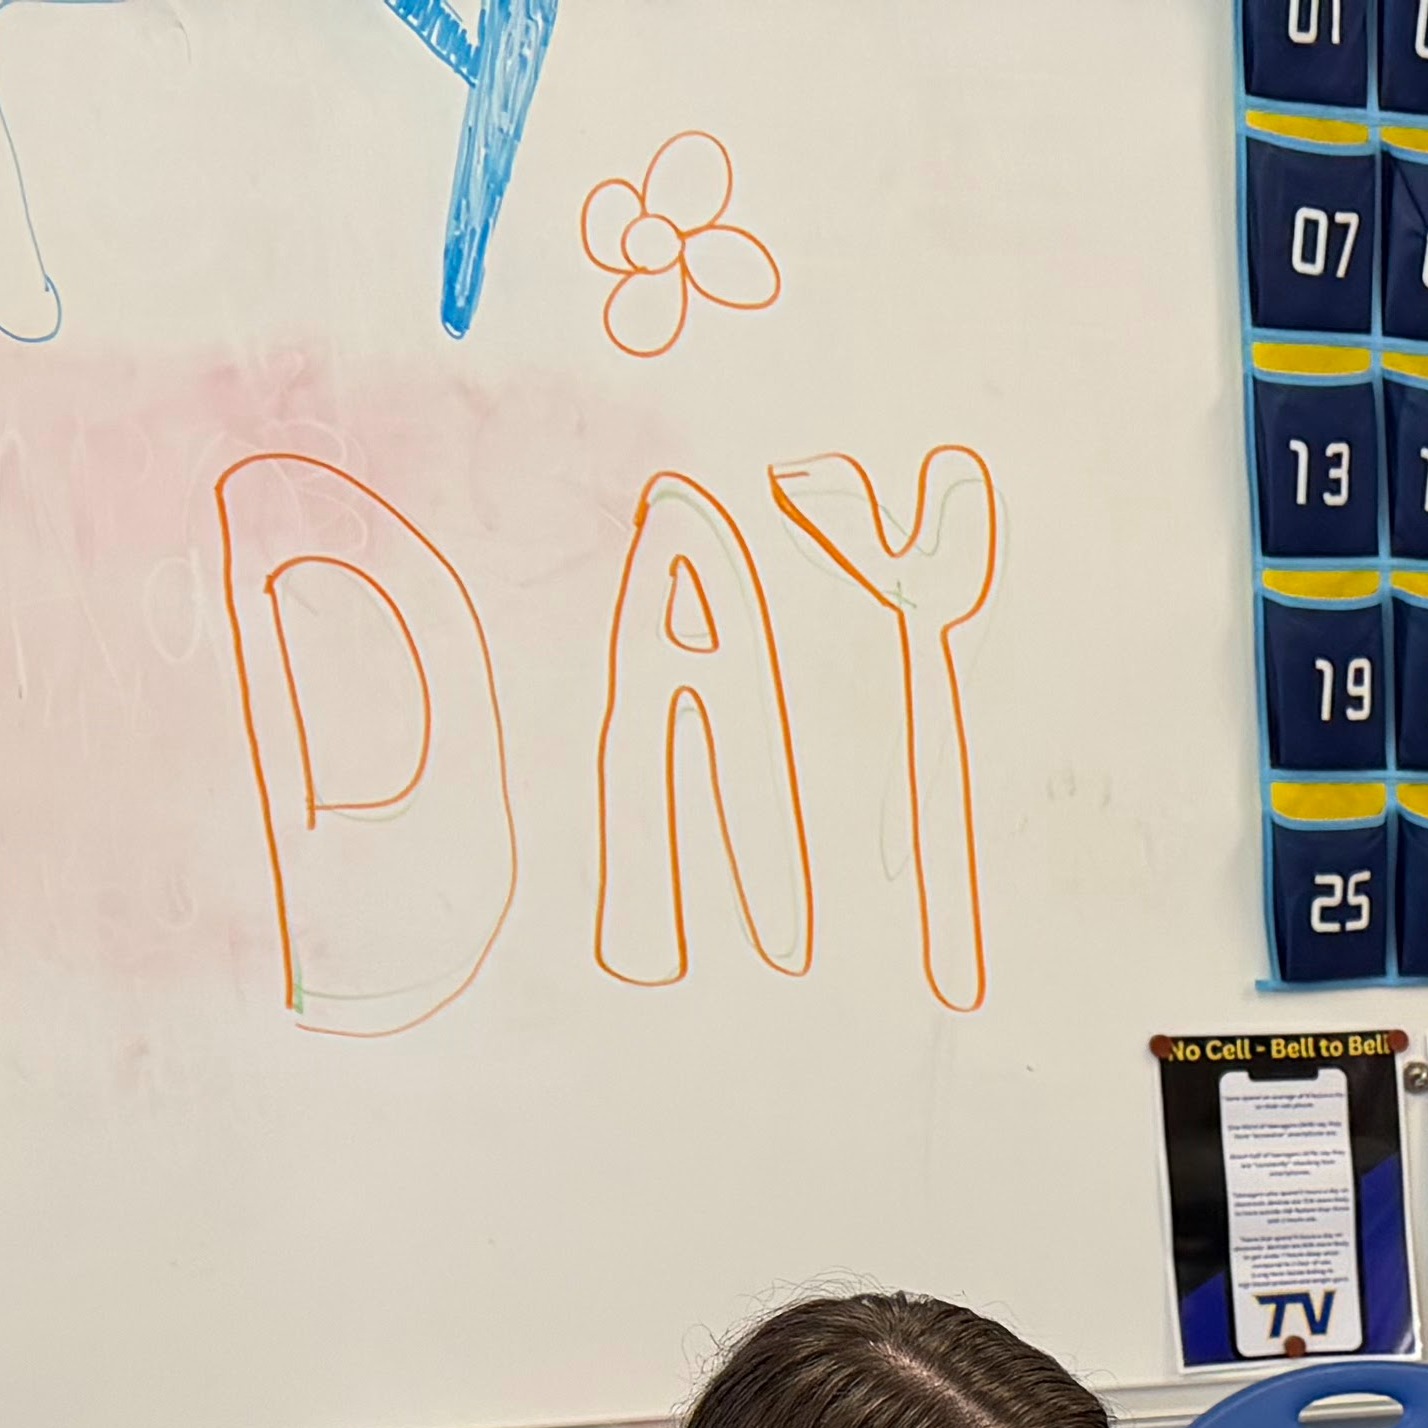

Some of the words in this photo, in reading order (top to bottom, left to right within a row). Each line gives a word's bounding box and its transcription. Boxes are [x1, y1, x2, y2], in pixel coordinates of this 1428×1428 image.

[1288, 0, 1341, 45] 01
[1291, 206, 1359, 278] 07
[1289, 439, 1350, 506] 13
[1315, 657, 1371, 721] 19
[213, 443, 998, 1038] DAY
[1310, 870, 1371, 933] 25
[1168, 1041, 1201, 1062] No
[1205, 1039, 1251, 1061] Cell
[1271, 1037, 1316, 1059] Bell
[1319, 1038, 1344, 1058] to
[1348, 1034, 1390, 1056] Bell
[1254, 1290, 1336, 1340] TV
